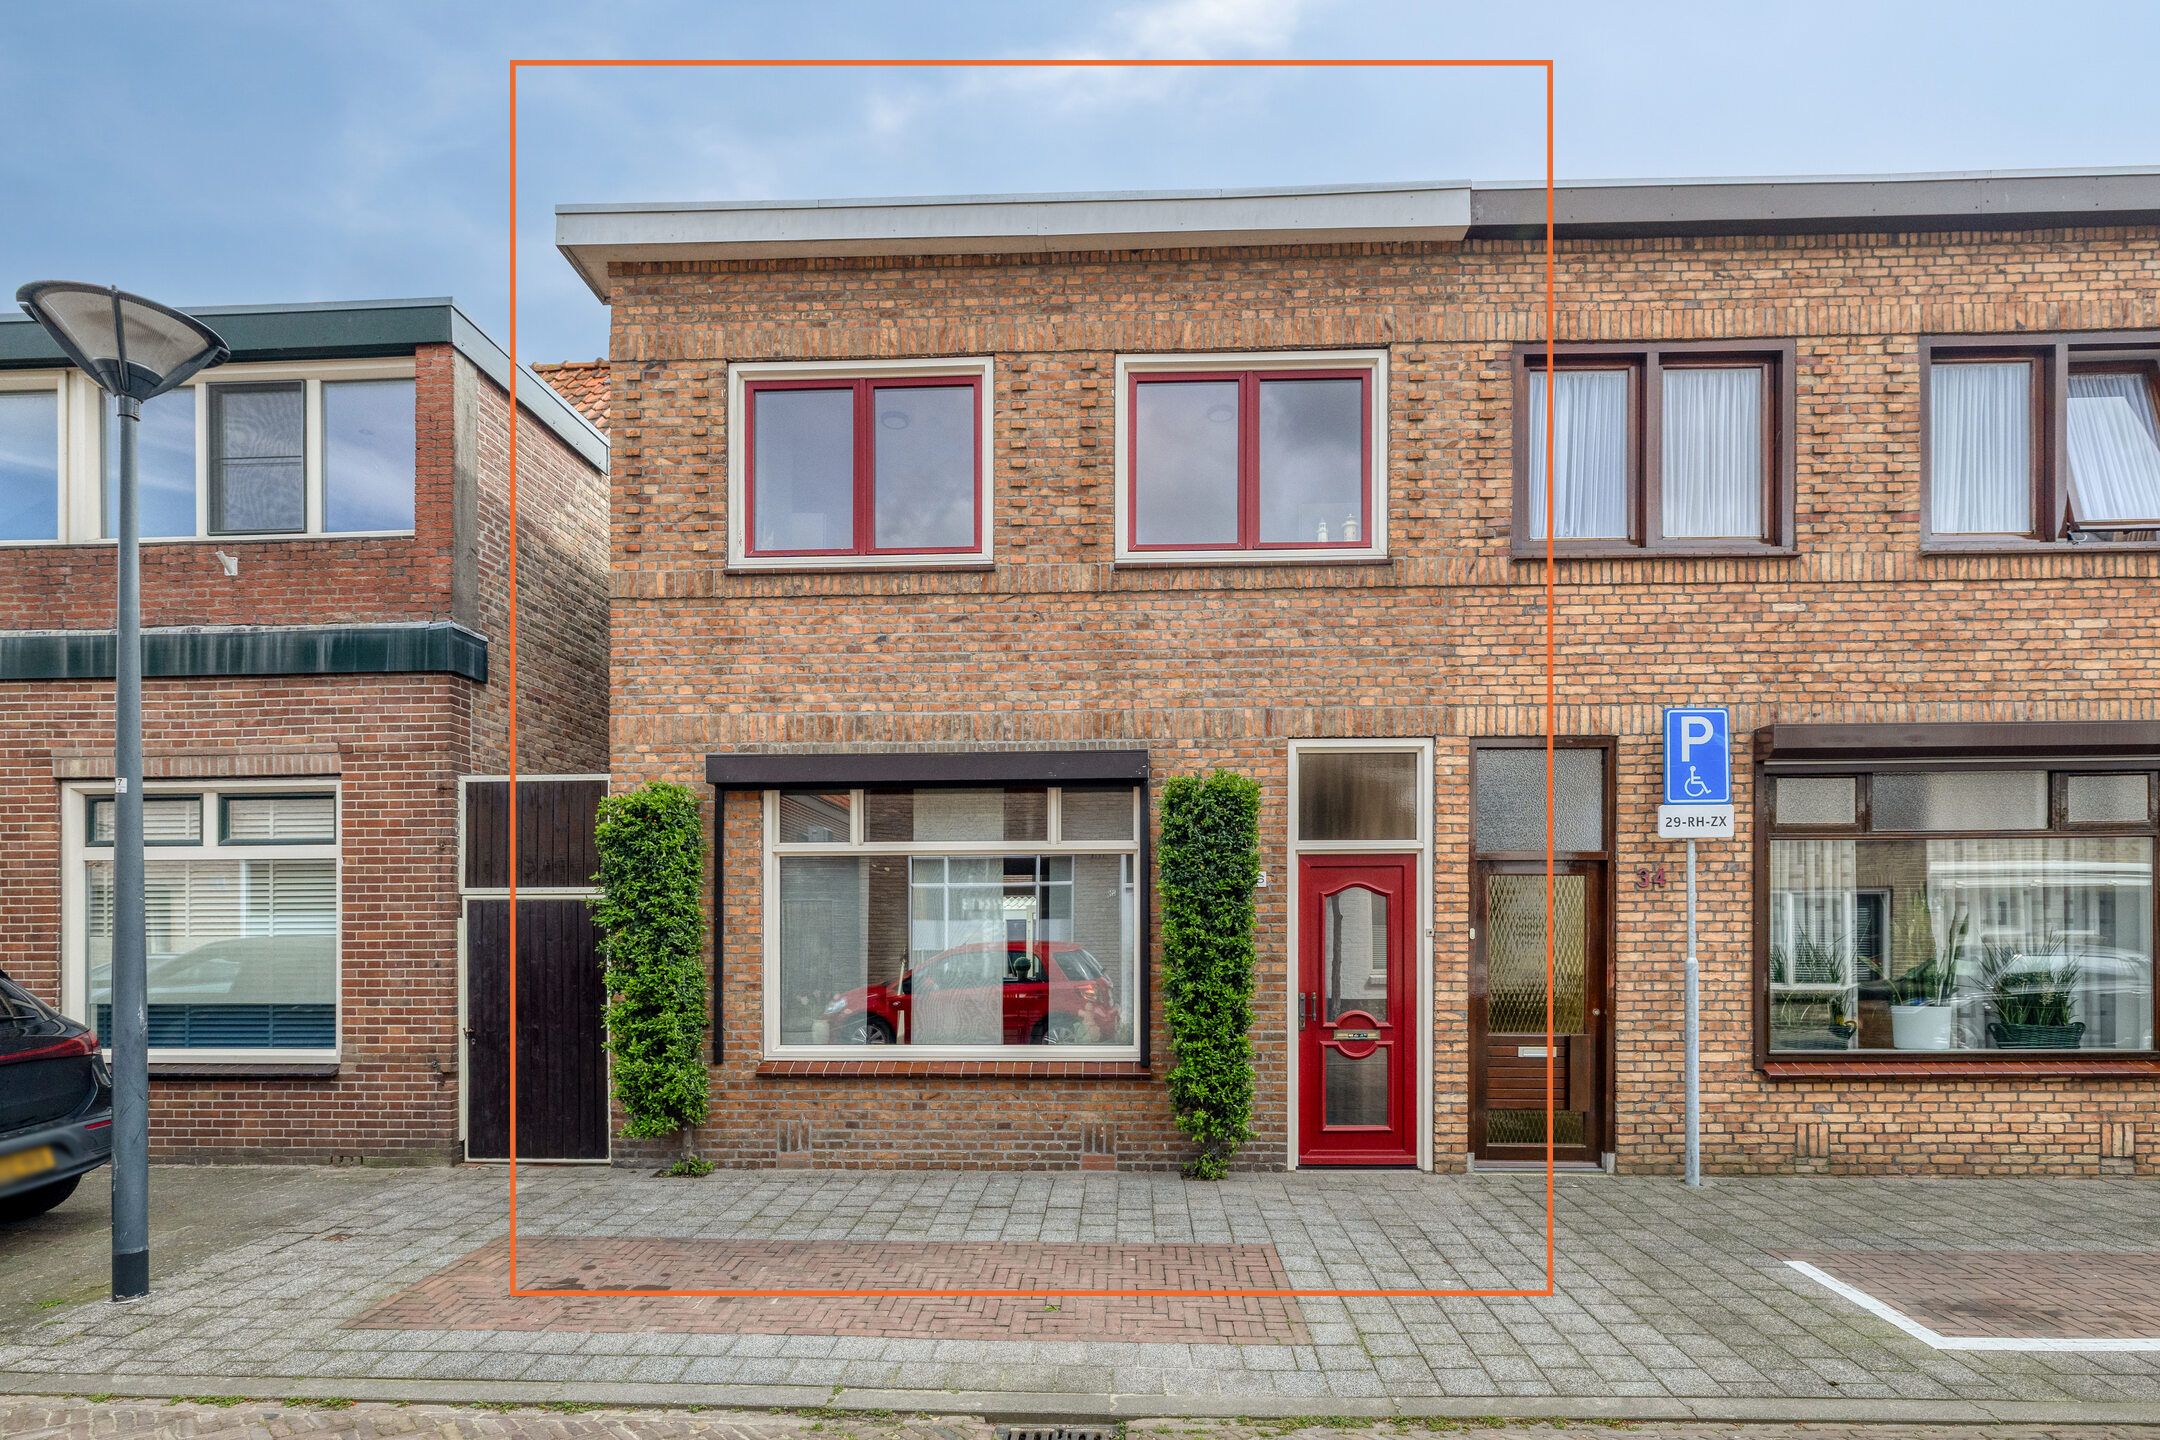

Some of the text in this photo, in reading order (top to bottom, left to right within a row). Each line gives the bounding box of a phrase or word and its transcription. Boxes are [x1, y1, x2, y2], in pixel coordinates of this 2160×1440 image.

[1681, 716, 1714, 762] P
[1665, 815, 1727, 828] 29-RH-ZX
[1636, 867, 1666, 888] 34
